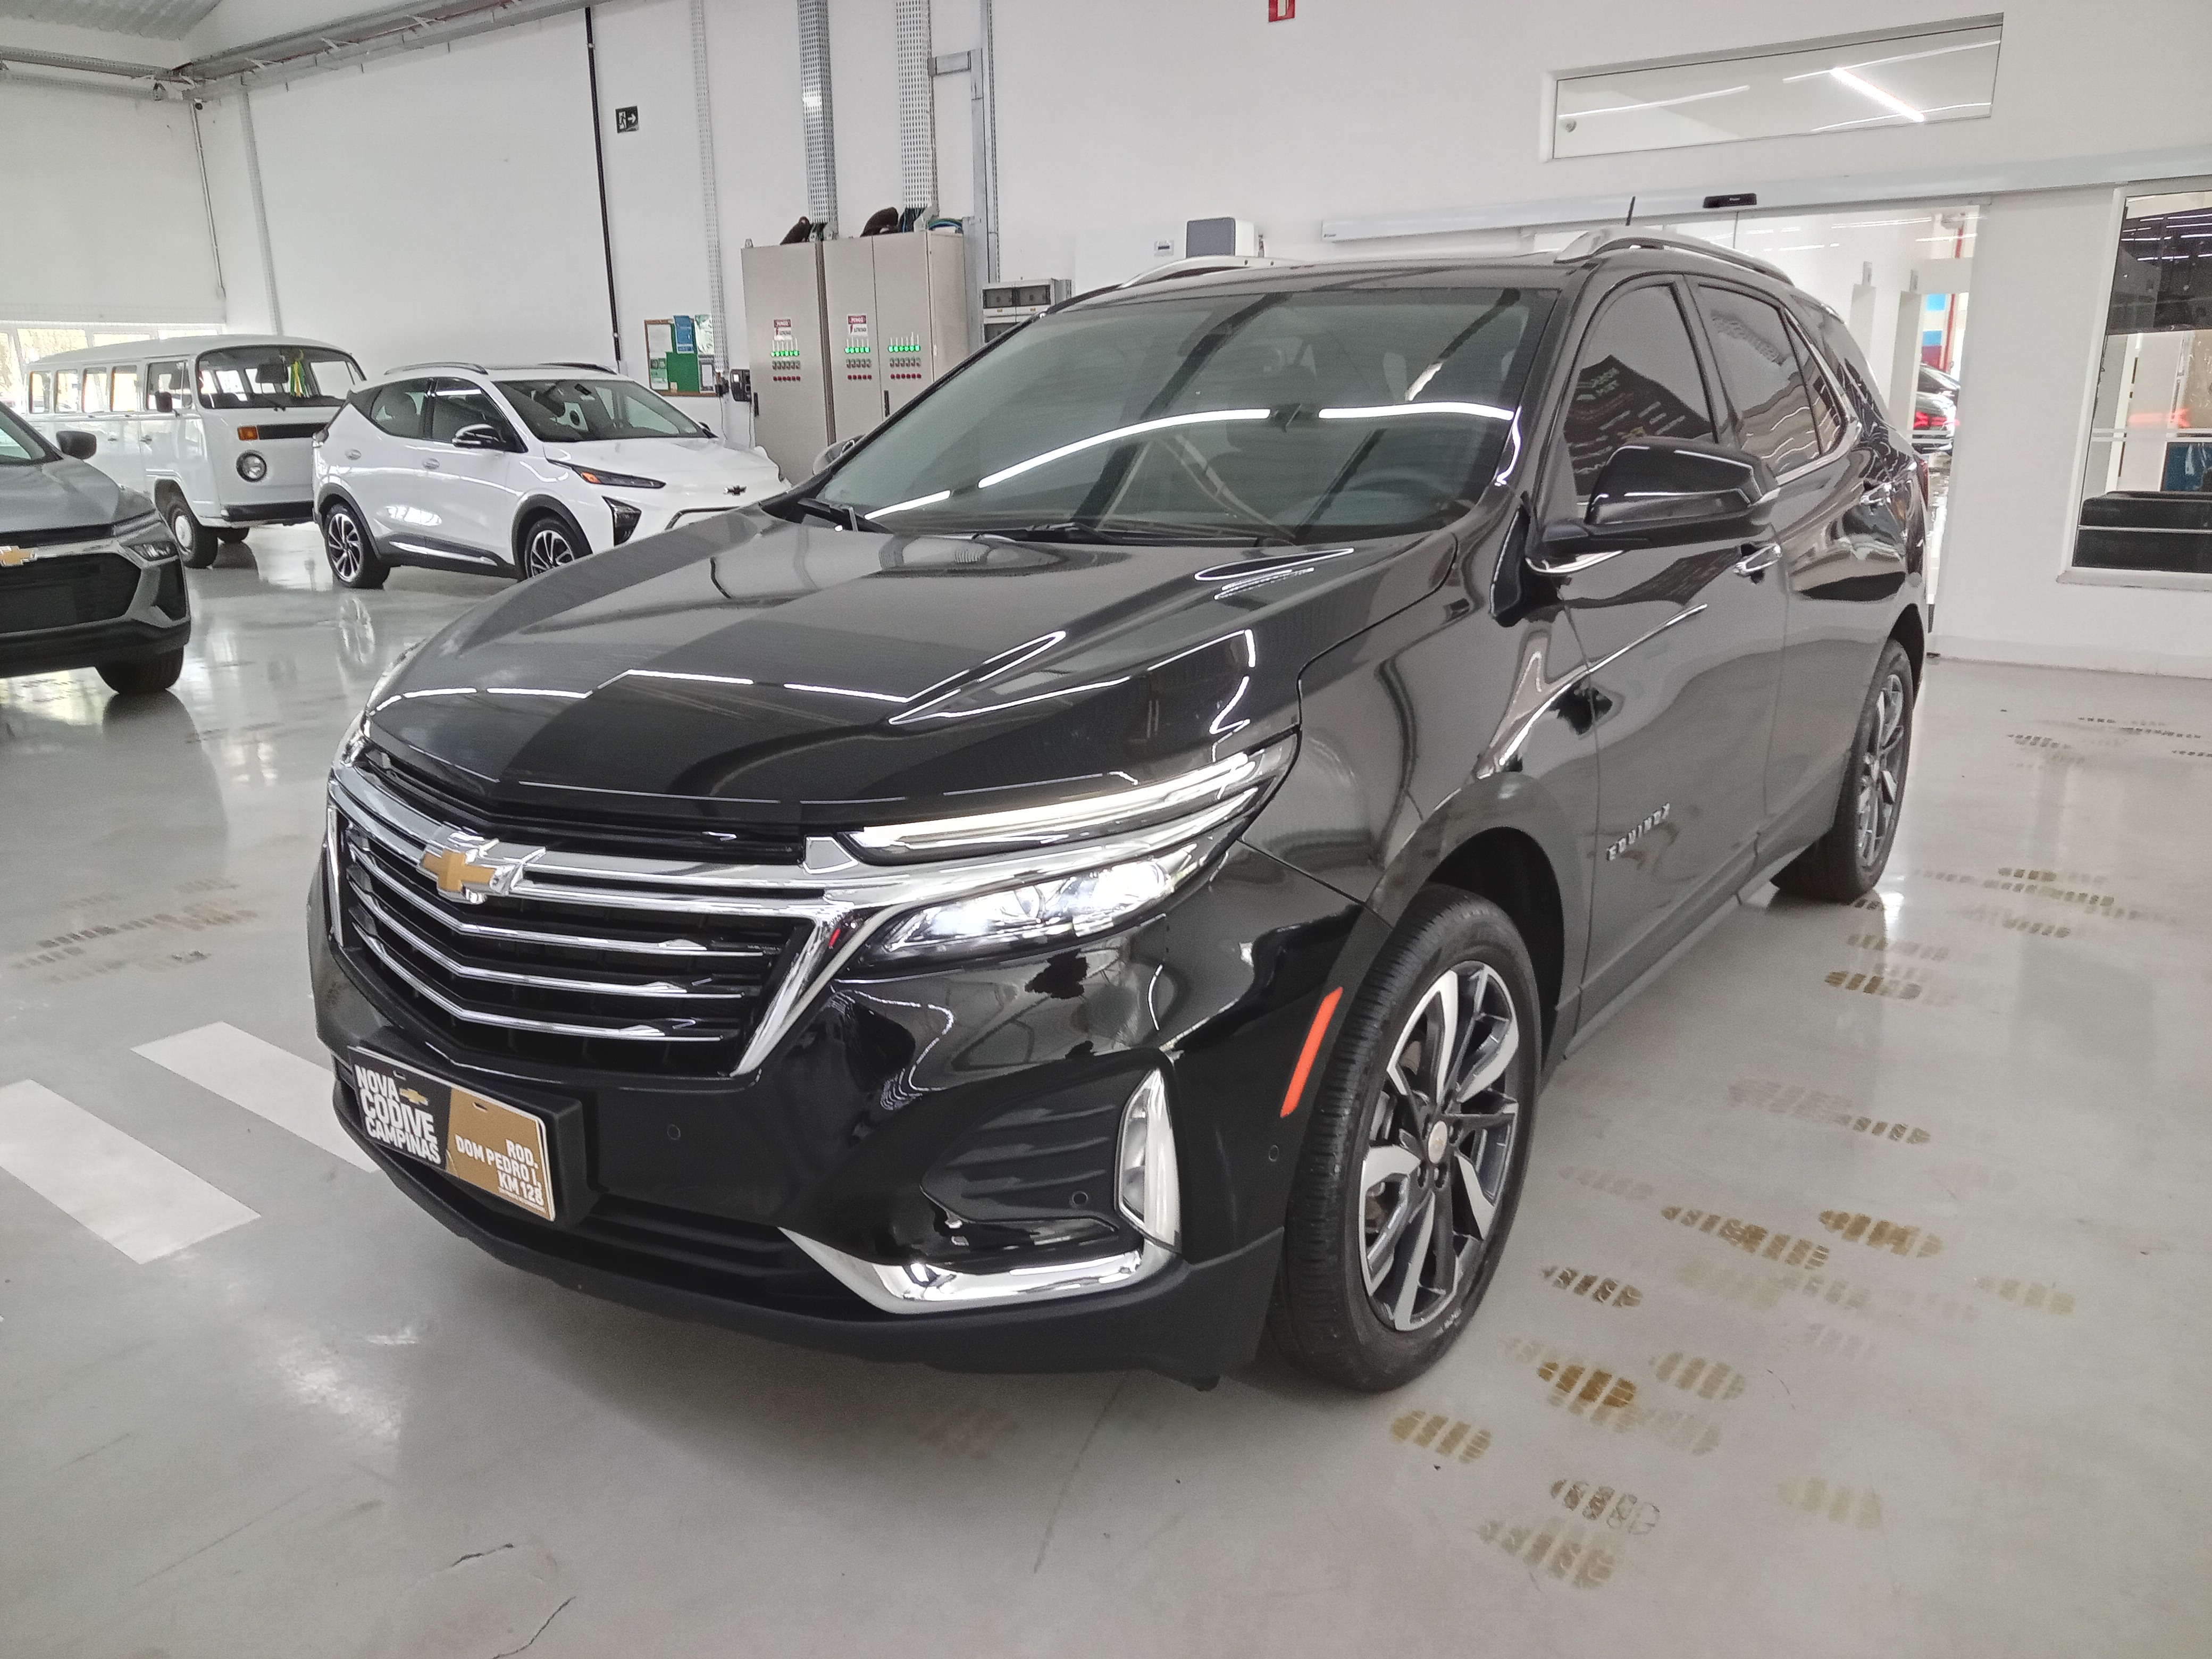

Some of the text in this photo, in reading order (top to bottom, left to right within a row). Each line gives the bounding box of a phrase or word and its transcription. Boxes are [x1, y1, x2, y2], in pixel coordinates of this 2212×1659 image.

[354, 1064, 400, 1103] NOVA
[360, 1088, 438, 1145] CODIVE
[365, 1117, 441, 1164] CAMPINAS
[455, 1134, 485, 1163] DOM
[485, 1146, 530, 1182] PEDRO
[505, 1138, 539, 1169] ROD.
[498, 1170, 520, 1196] KM
